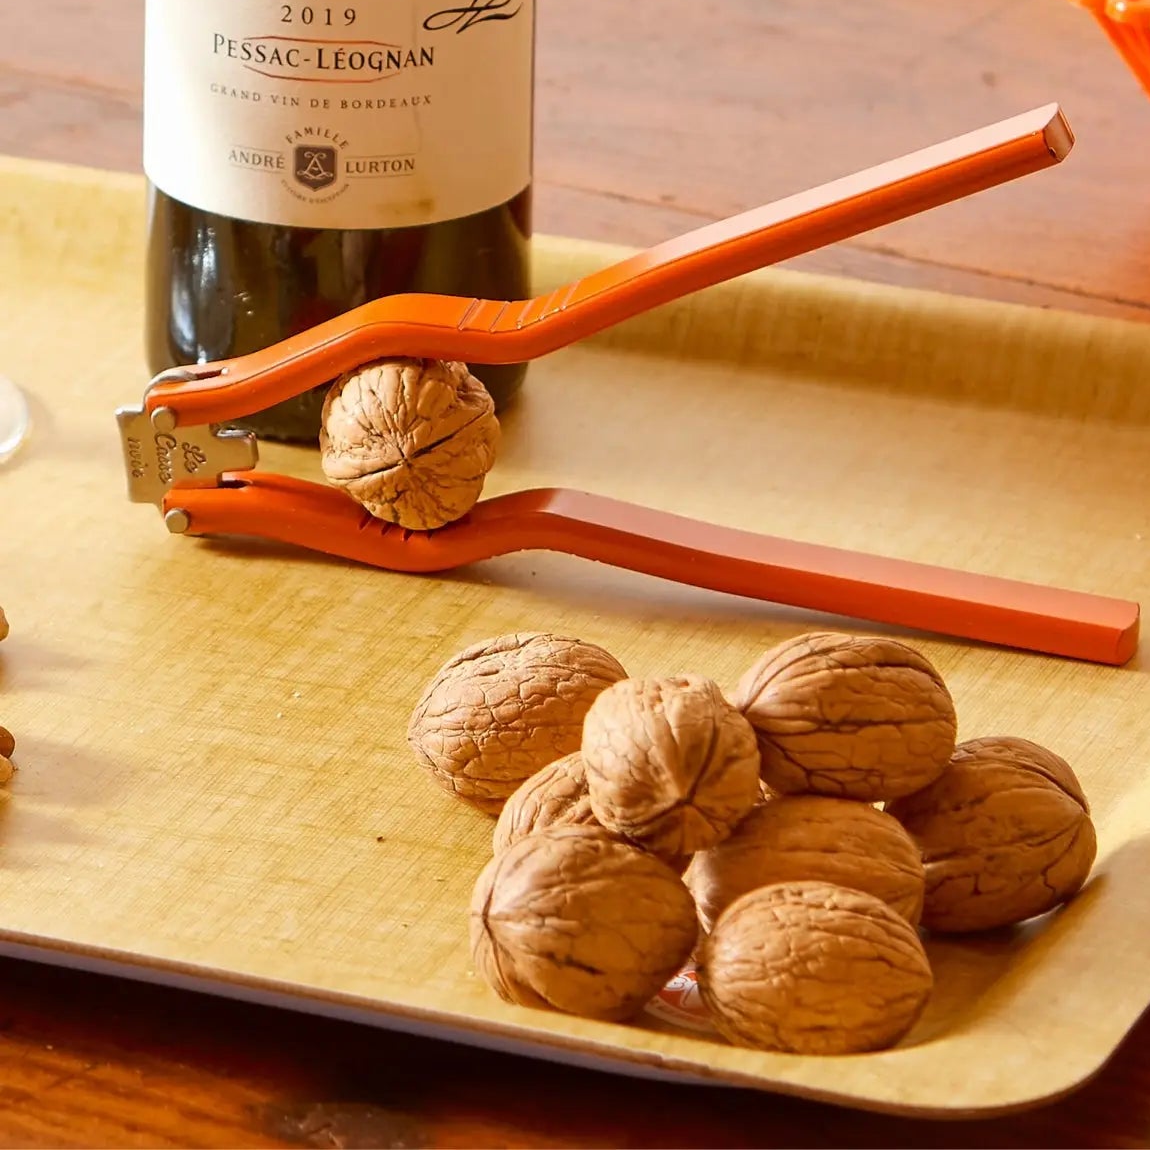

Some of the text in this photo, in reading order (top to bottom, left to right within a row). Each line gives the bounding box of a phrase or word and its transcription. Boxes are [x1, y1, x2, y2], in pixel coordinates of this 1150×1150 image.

[280, 4, 357, 26] 2019
[212, 32, 435, 74] PESSAC-LÉOGNAN
[210, 82, 432, 110] GRAND VIN DE BORDEAUX
[285, 126, 350, 151] FAMILLE
[228, 149, 416, 174] ANDRÉ LURTON
